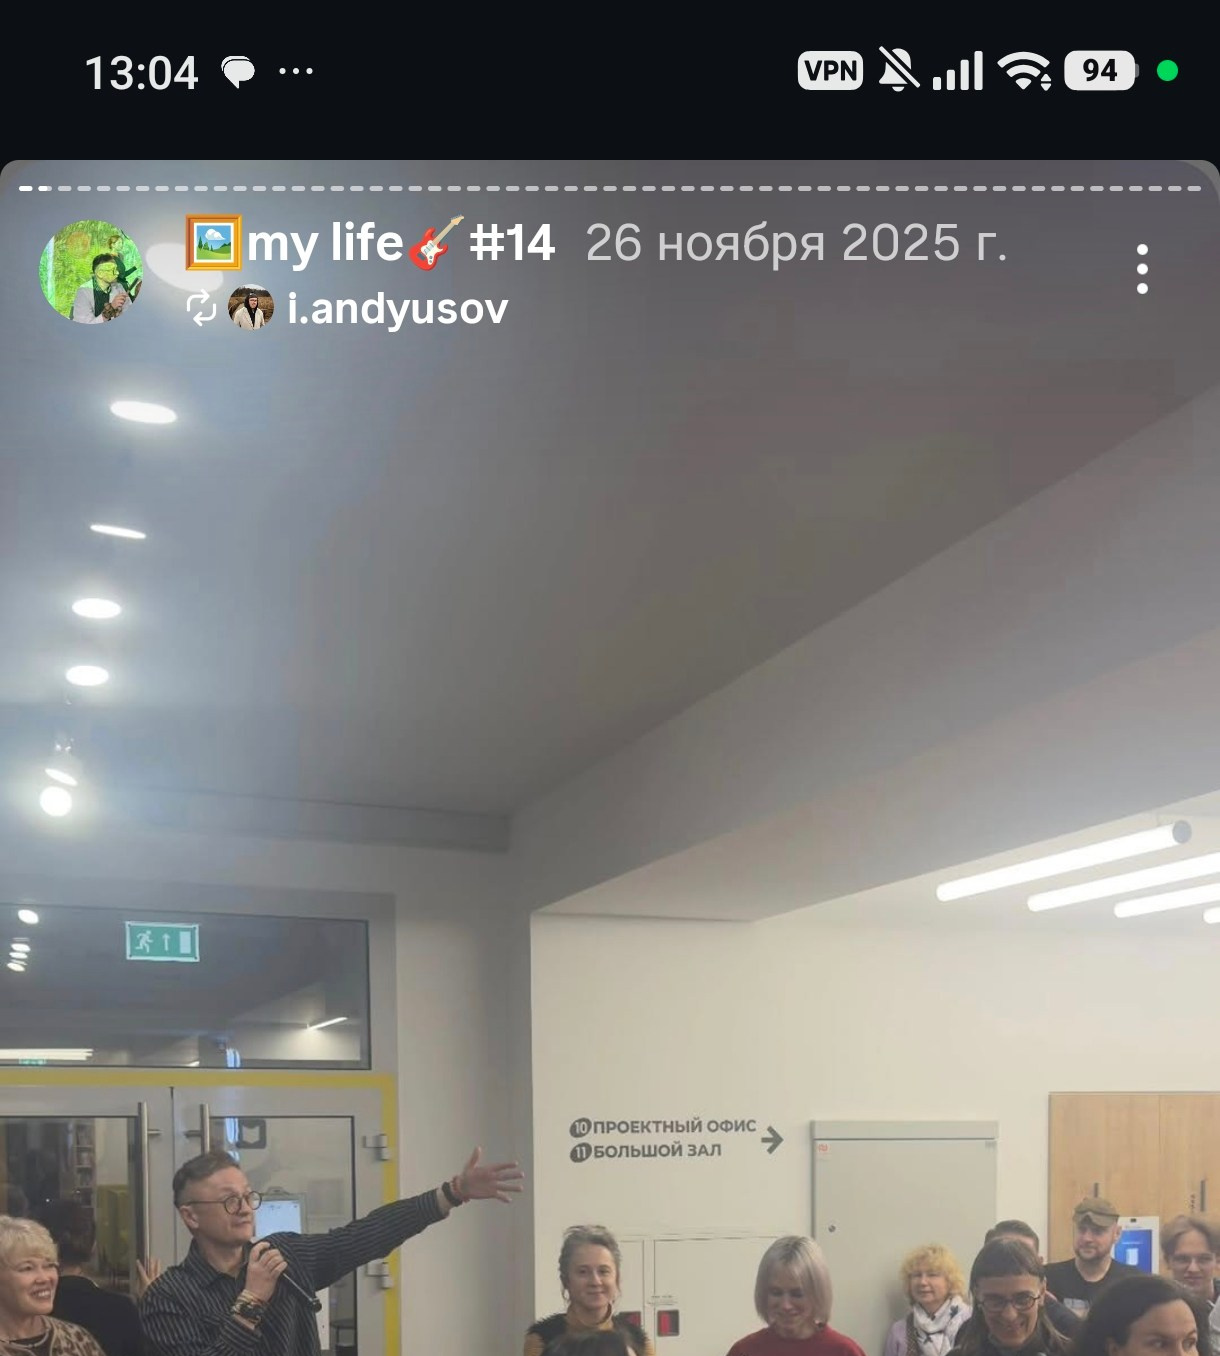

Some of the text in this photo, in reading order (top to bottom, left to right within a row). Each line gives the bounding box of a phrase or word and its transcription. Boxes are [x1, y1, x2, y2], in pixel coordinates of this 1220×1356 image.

[593, 1117, 703, 1135] ПРОЕКТНЫЙ
[706, 1119, 757, 1134] ОФИС
[593, 1141, 683, 1159] БОЛЬШОЙ
[687, 1143, 722, 1157] ЗАЛ
